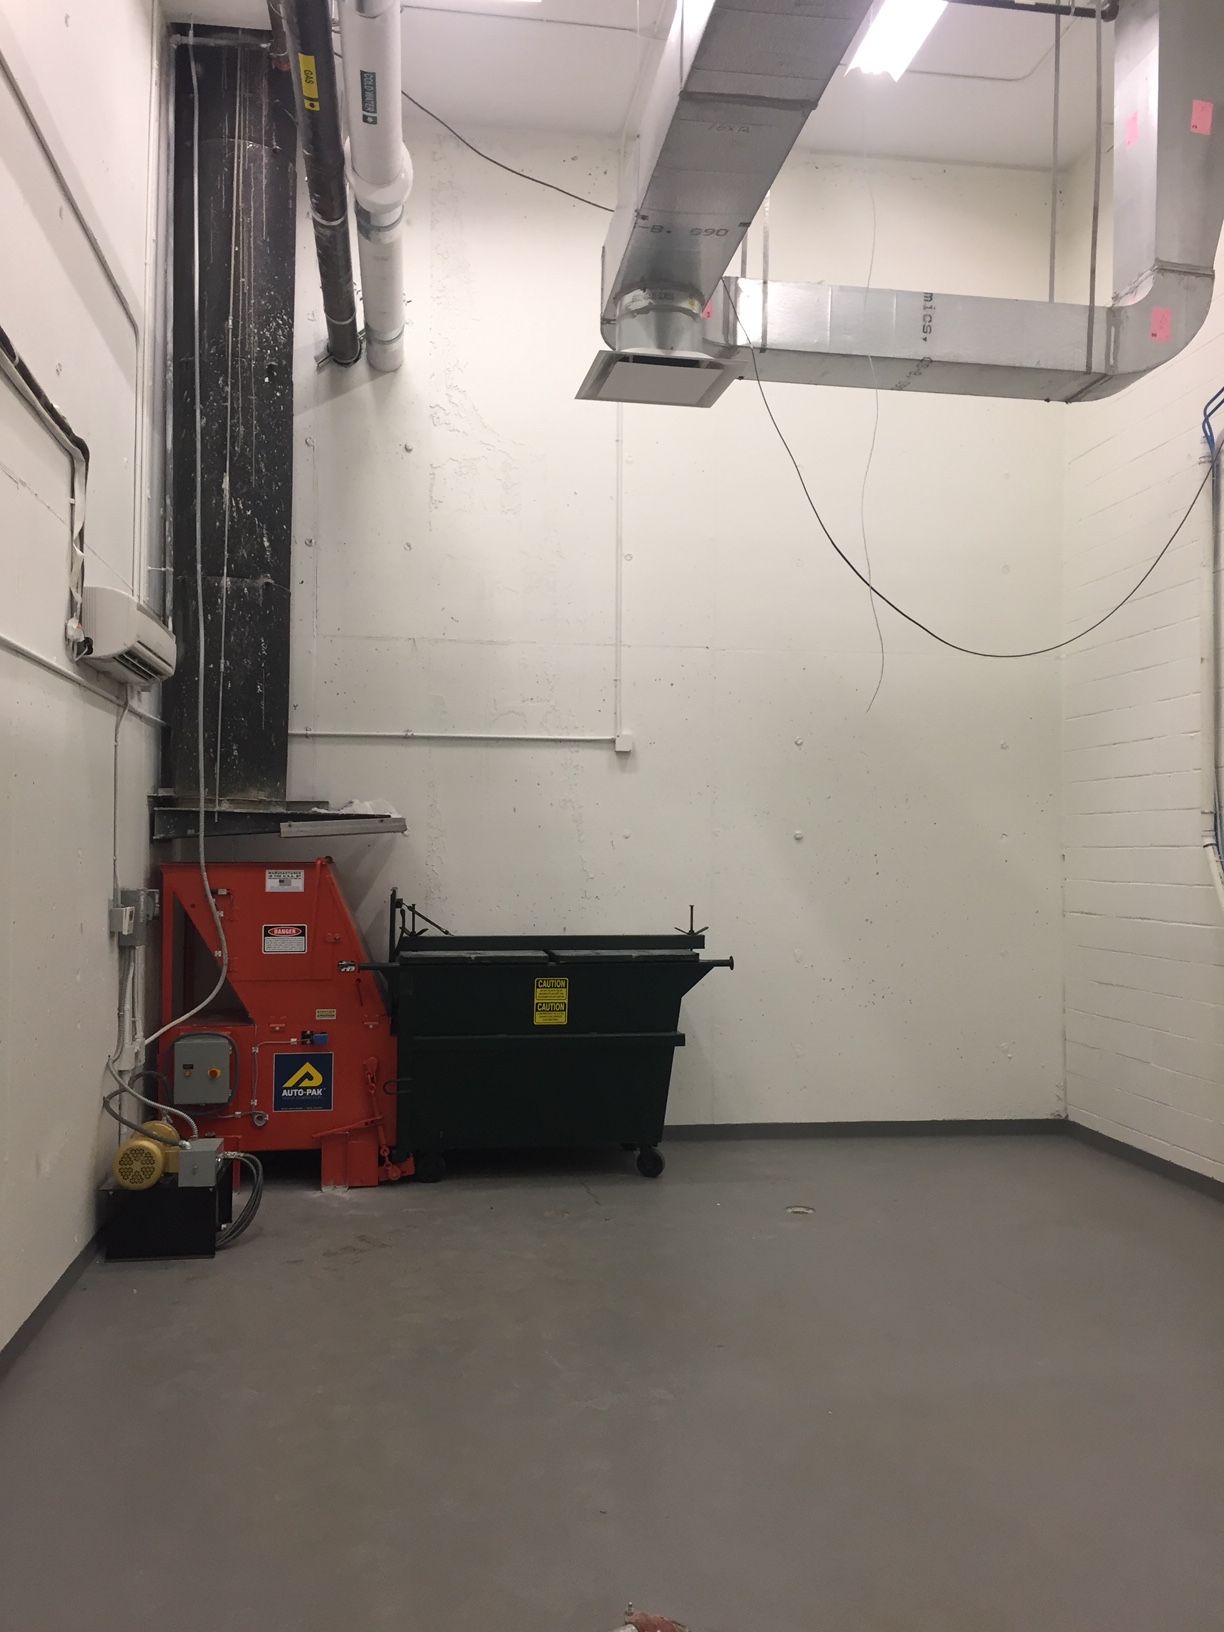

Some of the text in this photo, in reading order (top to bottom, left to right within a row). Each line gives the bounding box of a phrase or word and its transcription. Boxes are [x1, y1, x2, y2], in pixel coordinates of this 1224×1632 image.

[303, 69, 314, 84] GAS
[363, 73, 375, 111] COLD WATER
[538, 979, 566, 988] CAUTION
[537, 1002, 565, 1011] CAUTION
[281, 1088, 323, 1097] AUTO-PAK
